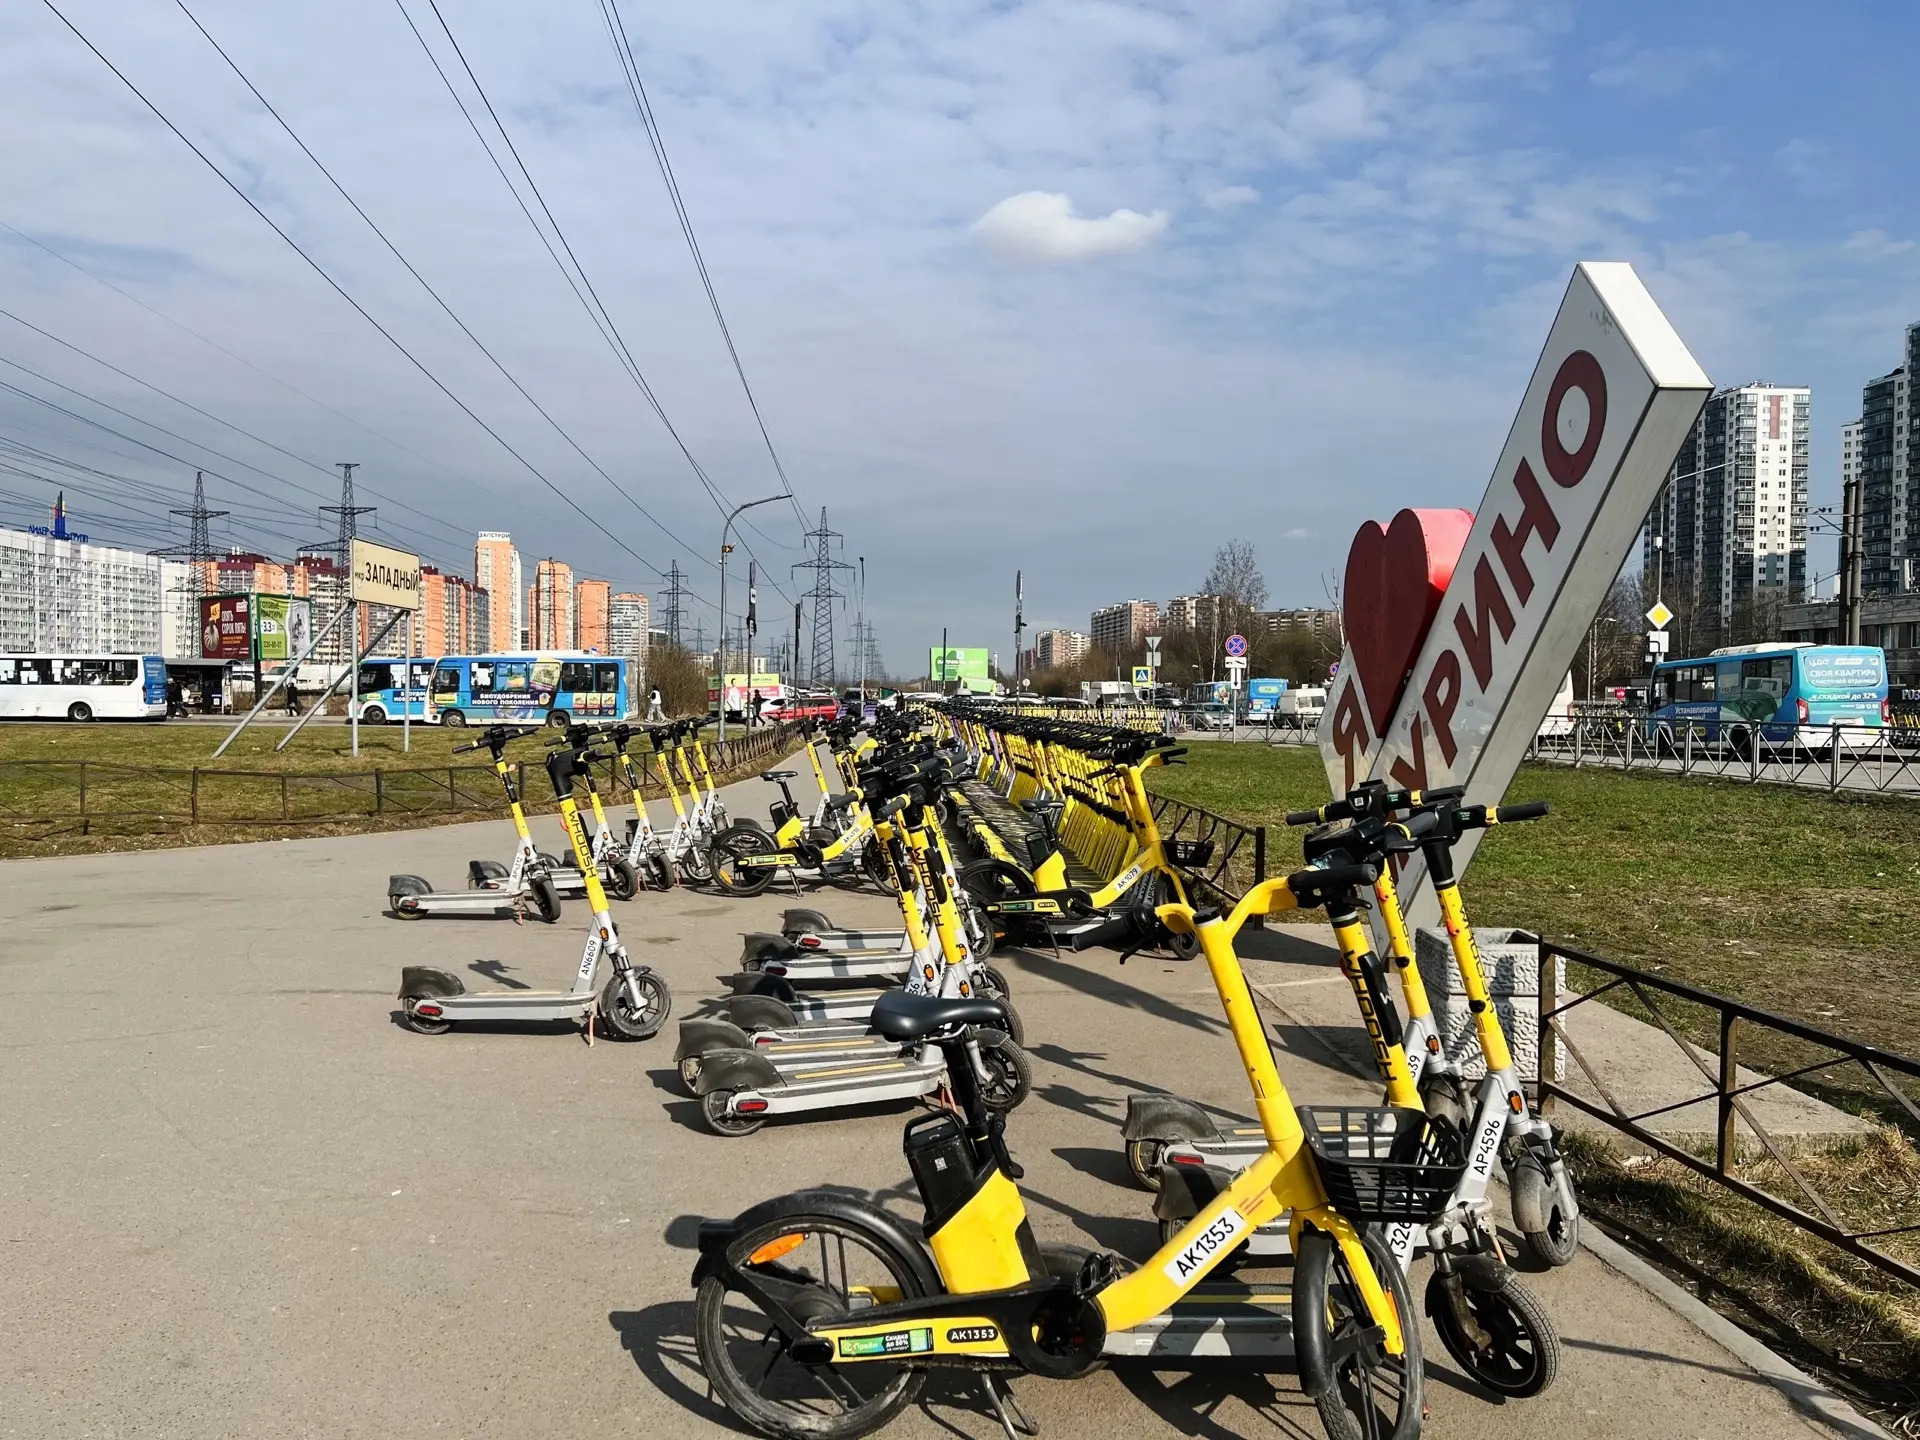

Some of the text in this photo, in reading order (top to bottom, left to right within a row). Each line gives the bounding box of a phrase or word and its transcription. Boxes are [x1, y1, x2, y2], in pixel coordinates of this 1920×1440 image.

[365, 561, 419, 592] ЗАПАДНЫЙ
[1384, 350, 1608, 887] УРИНО
[1809, 669, 1877, 677] СВОЯ КВАРТИРА
[1333, 674, 1370, 795] Я
[568, 810, 597, 879] WHOOSH
[914, 847, 944, 927] WHOOSH
[1117, 867, 1138, 889] AK1079
[581, 939, 598, 976] AN6609
[1343, 950, 1398, 1082] WHOOSH
[1473, 1119, 1500, 1176] AP4596
[1176, 1216, 1235, 1278] AK1353
[885, 1333, 909, 1342] Скидка
[951, 1328, 995, 1340] AK1353
